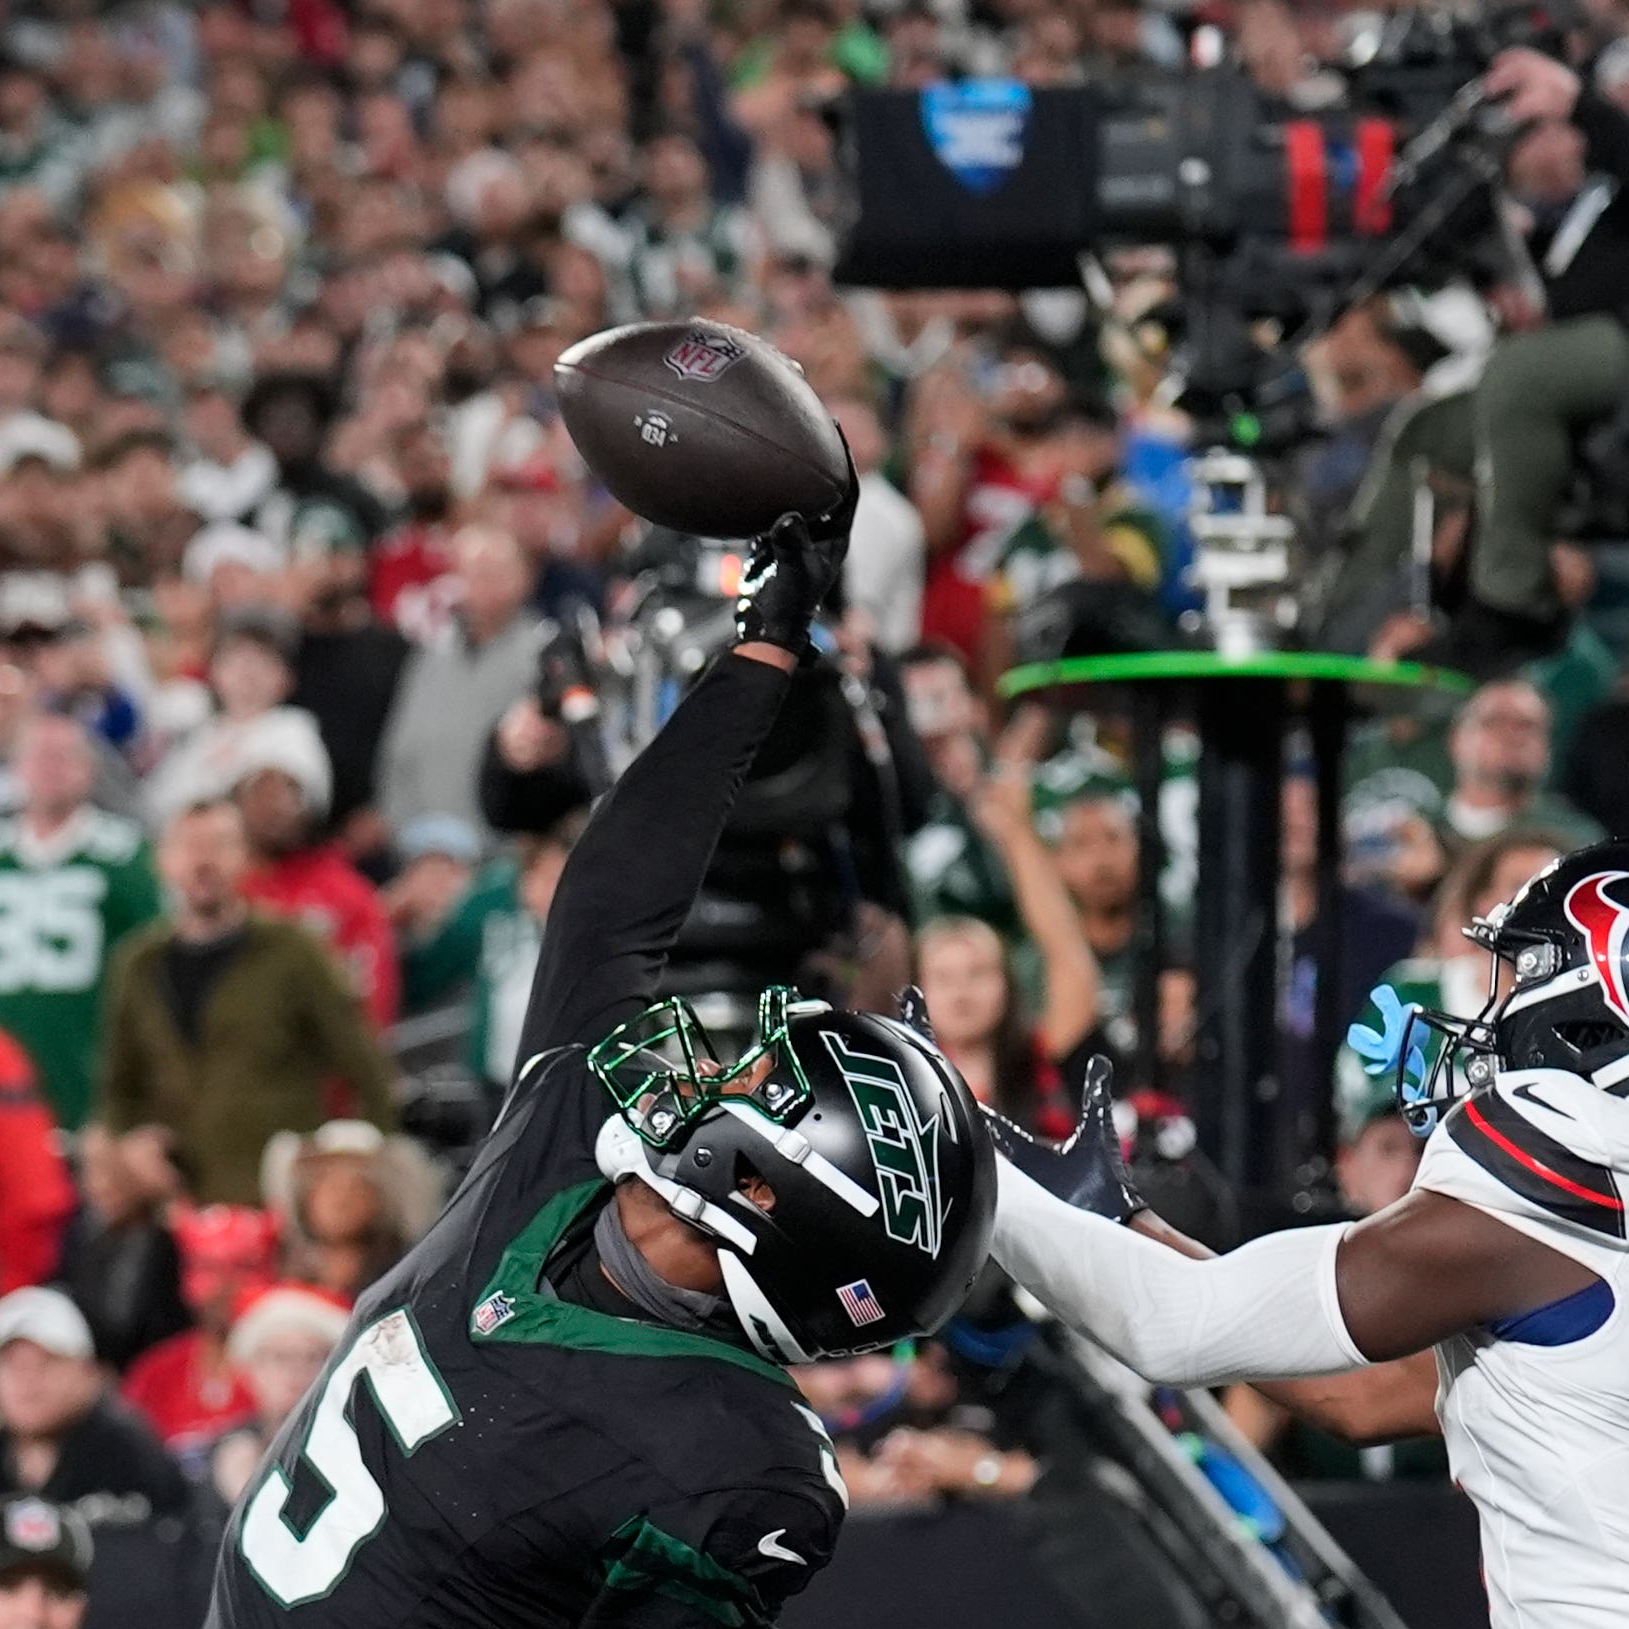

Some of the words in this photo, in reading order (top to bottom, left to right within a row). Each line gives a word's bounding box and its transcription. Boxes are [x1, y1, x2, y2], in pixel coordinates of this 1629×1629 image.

[673, 342, 718, 375] NFL
[819, 1030, 939, 1258] JETS
[241, 1304, 462, 1611] 5
